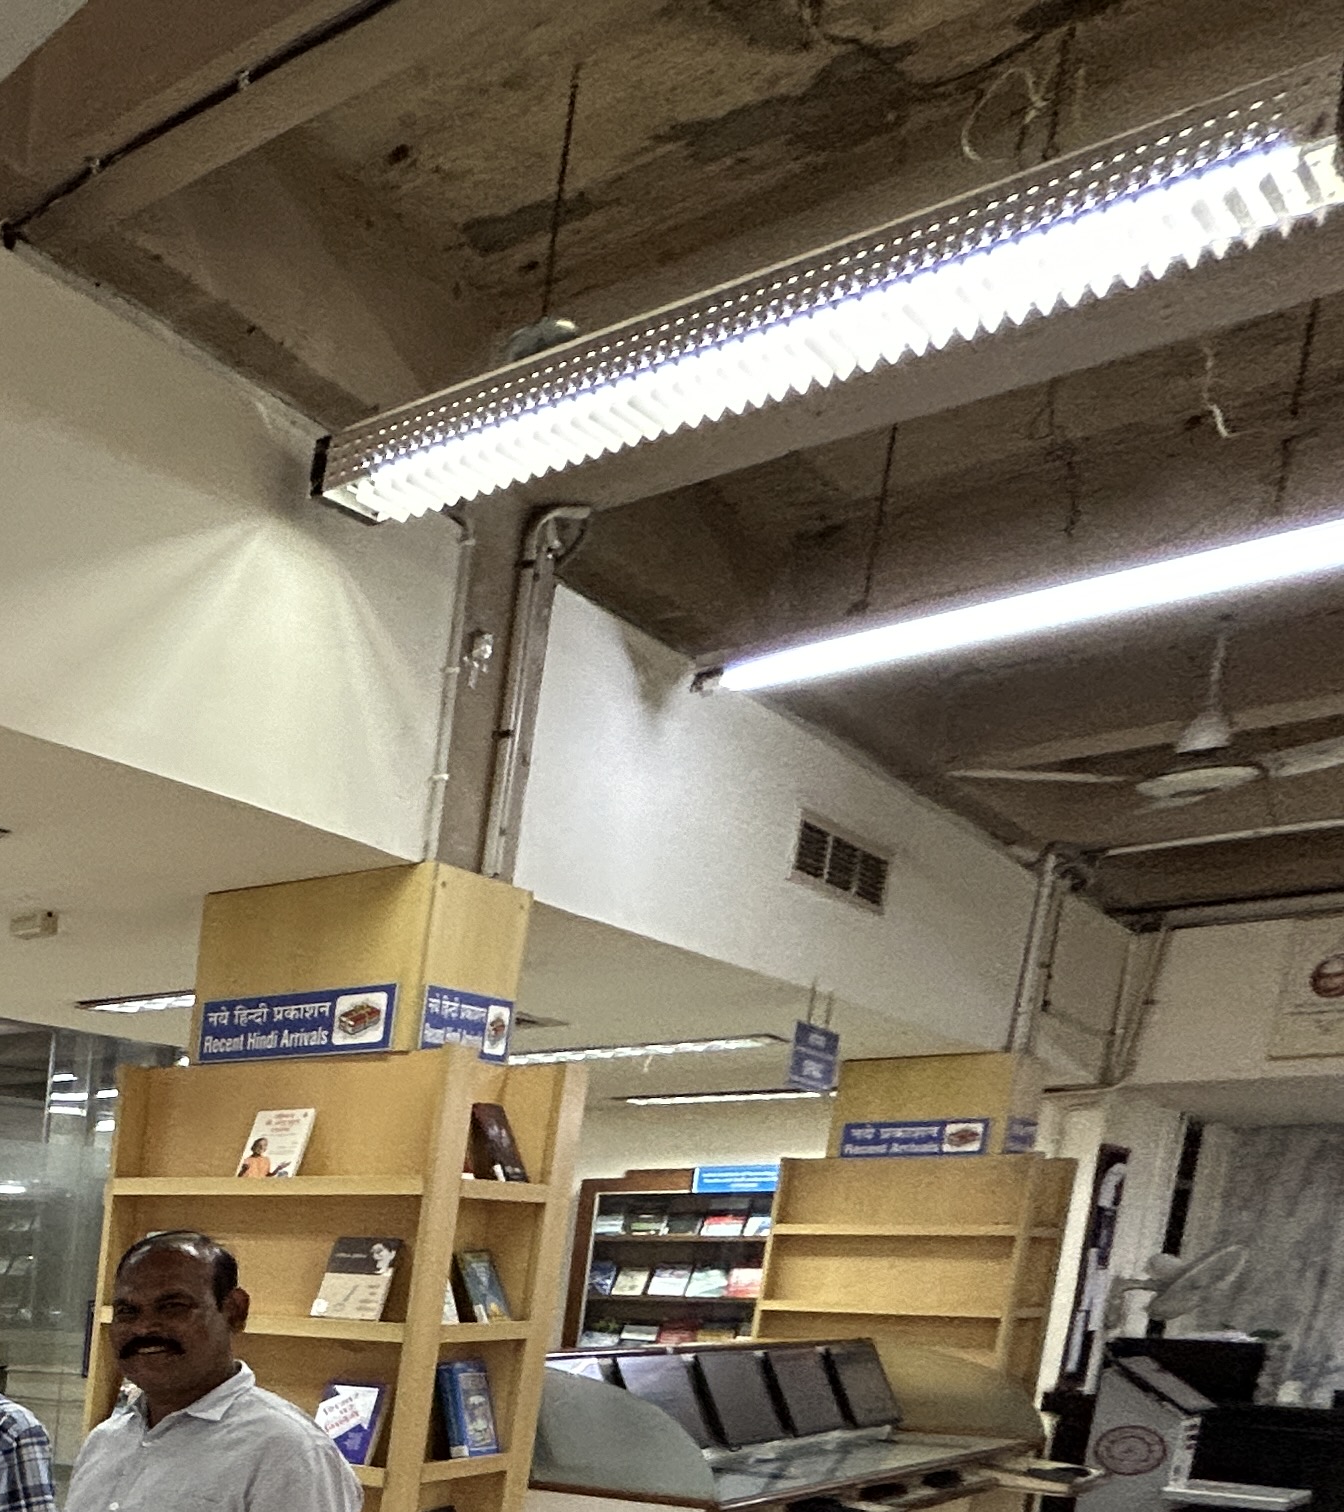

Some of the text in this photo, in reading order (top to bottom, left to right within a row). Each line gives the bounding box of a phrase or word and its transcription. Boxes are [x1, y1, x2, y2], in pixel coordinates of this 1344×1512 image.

[207, 1002, 331, 1027] नये हिन्दी प्रकाशन
[203, 1026, 328, 1053] Recent Hindi Arrivals
